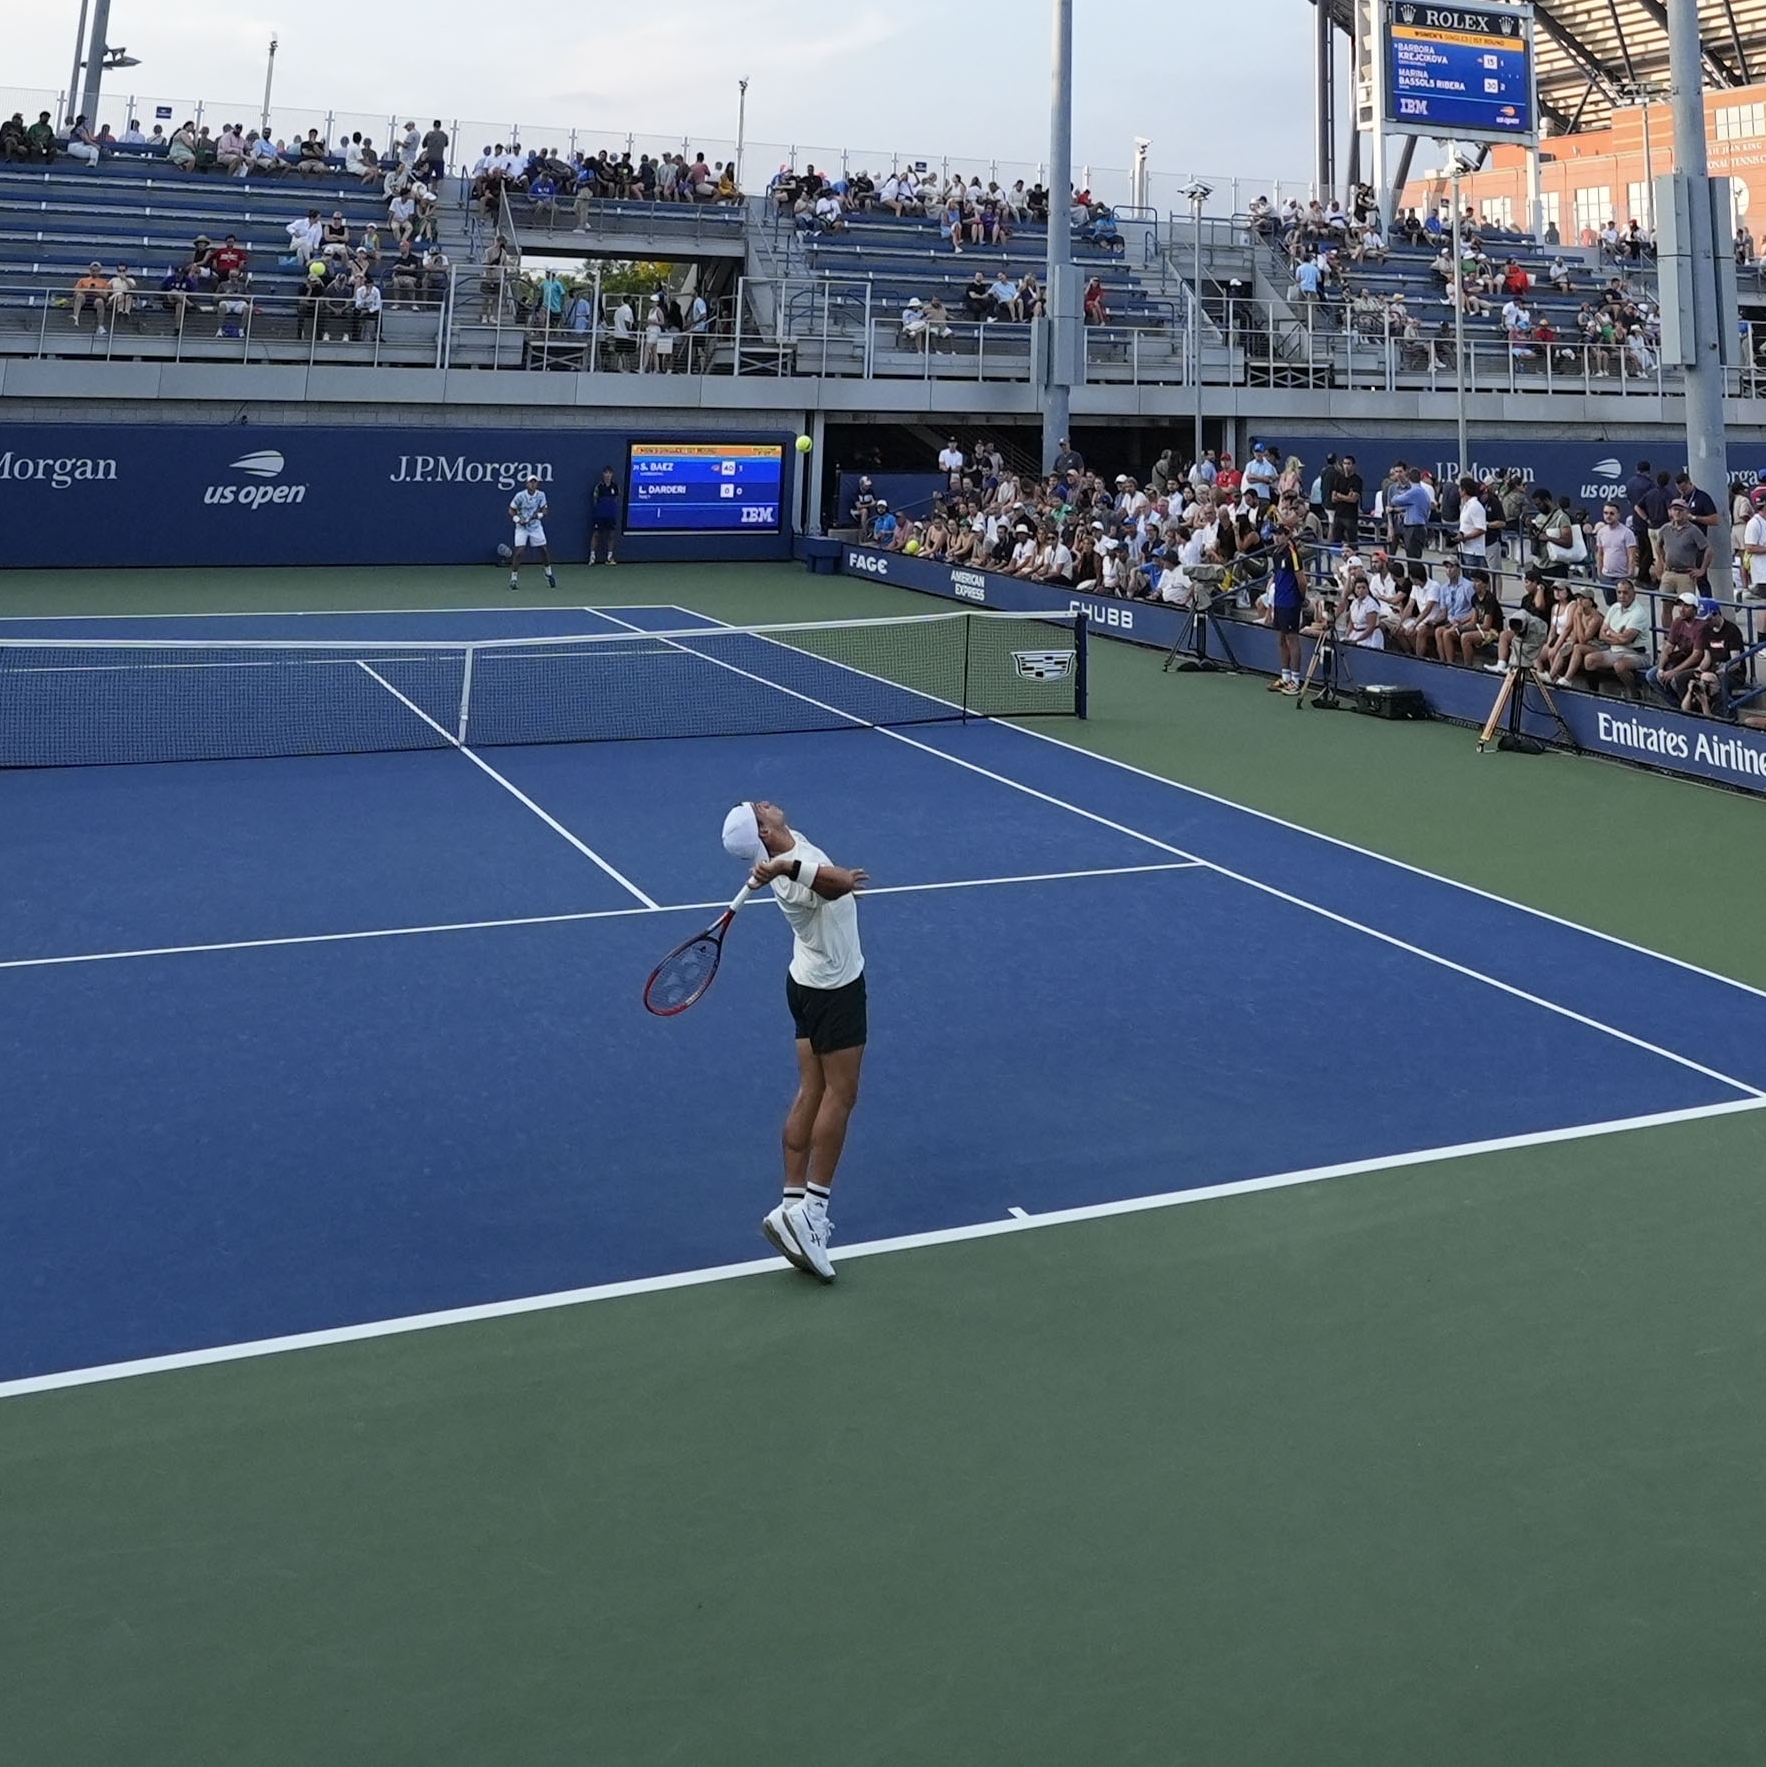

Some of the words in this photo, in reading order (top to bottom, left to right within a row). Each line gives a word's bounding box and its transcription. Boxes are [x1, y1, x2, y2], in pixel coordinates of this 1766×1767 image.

[1426, 9, 1490, 32] ROLEX
[1398, 43, 1435, 54] BARBORA
[1398, 68, 1428, 79] MARINA
[1400, 98, 1428, 115] IBM
[650, 463, 674, 472] BAEZ
[203, 484, 235, 505] us
[238, 483, 307, 510] open
[648, 485, 686, 494] DARDERI
[736, 487, 743, 495] 0
[1580, 484, 1597, 498] us
[1598, 483, 1627, 501] ope
[741, 507, 774, 523] IBM
[950, 570, 985, 588] AMERICAN
[954, 585, 985, 602] EXPRESS
[1597, 712, 1688, 758] Emirates
